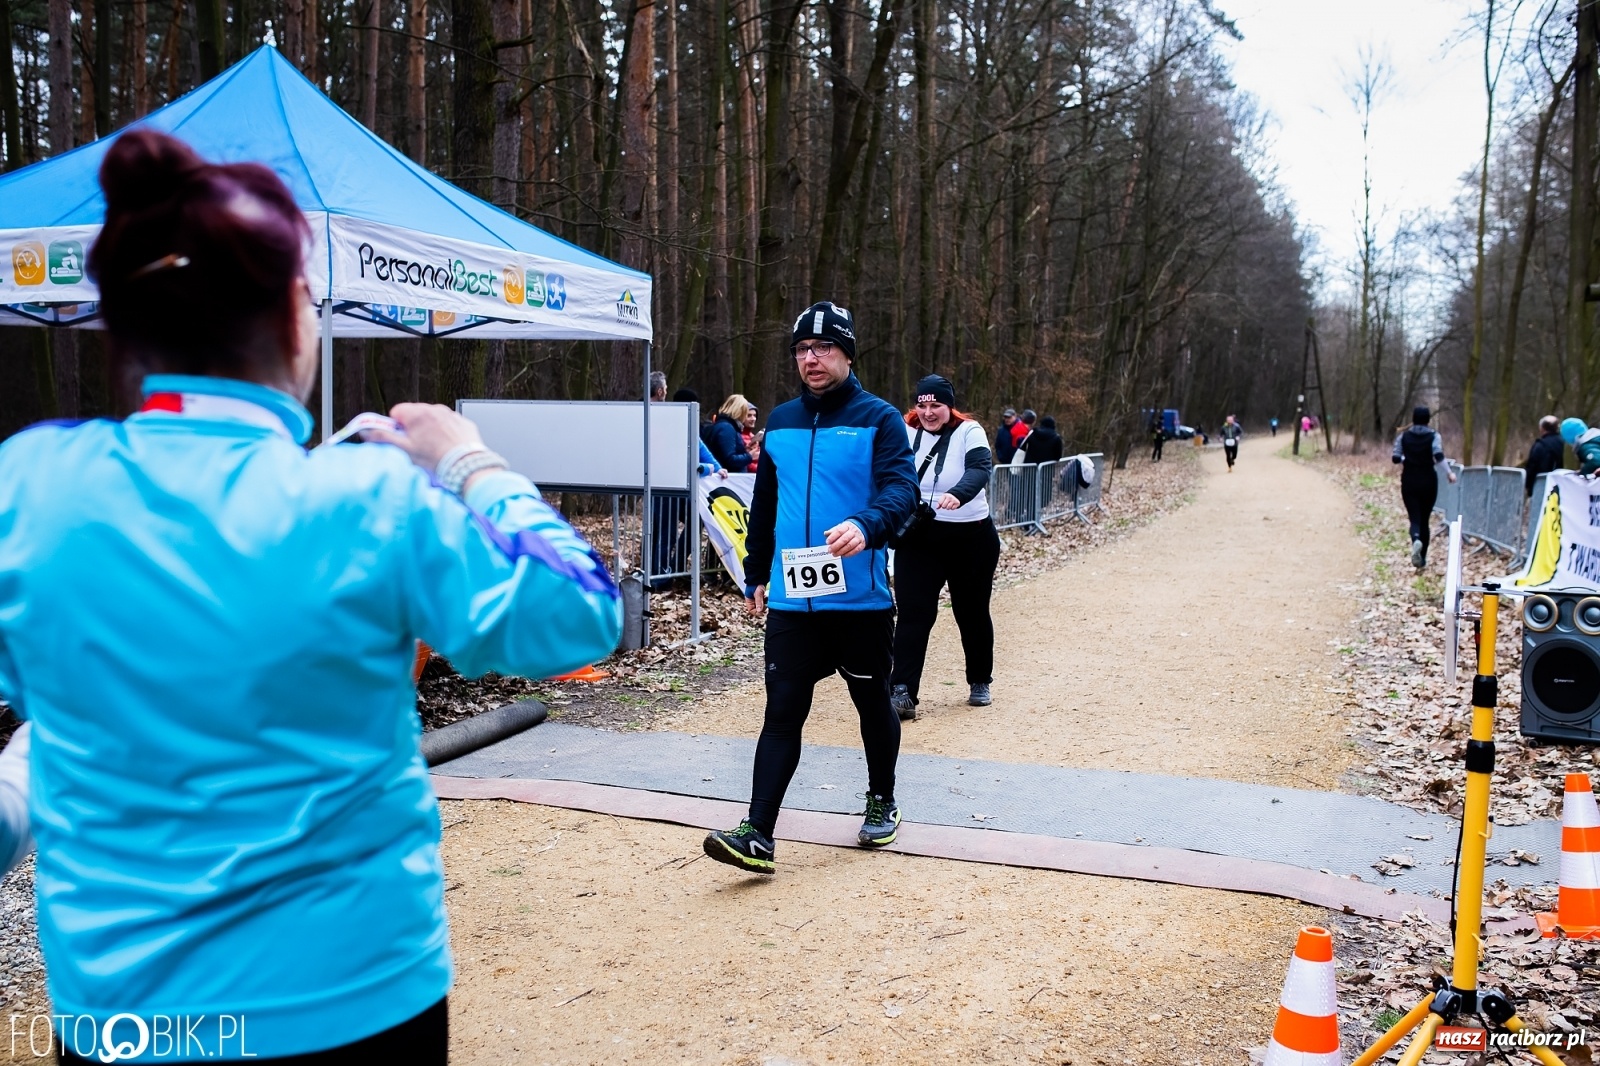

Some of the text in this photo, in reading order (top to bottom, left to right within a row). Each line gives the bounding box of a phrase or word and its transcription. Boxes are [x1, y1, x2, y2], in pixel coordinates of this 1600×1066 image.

[358, 242, 498, 298] PersonalBest
[917, 394, 937, 403] COOL
[786, 563, 840, 589] 196
